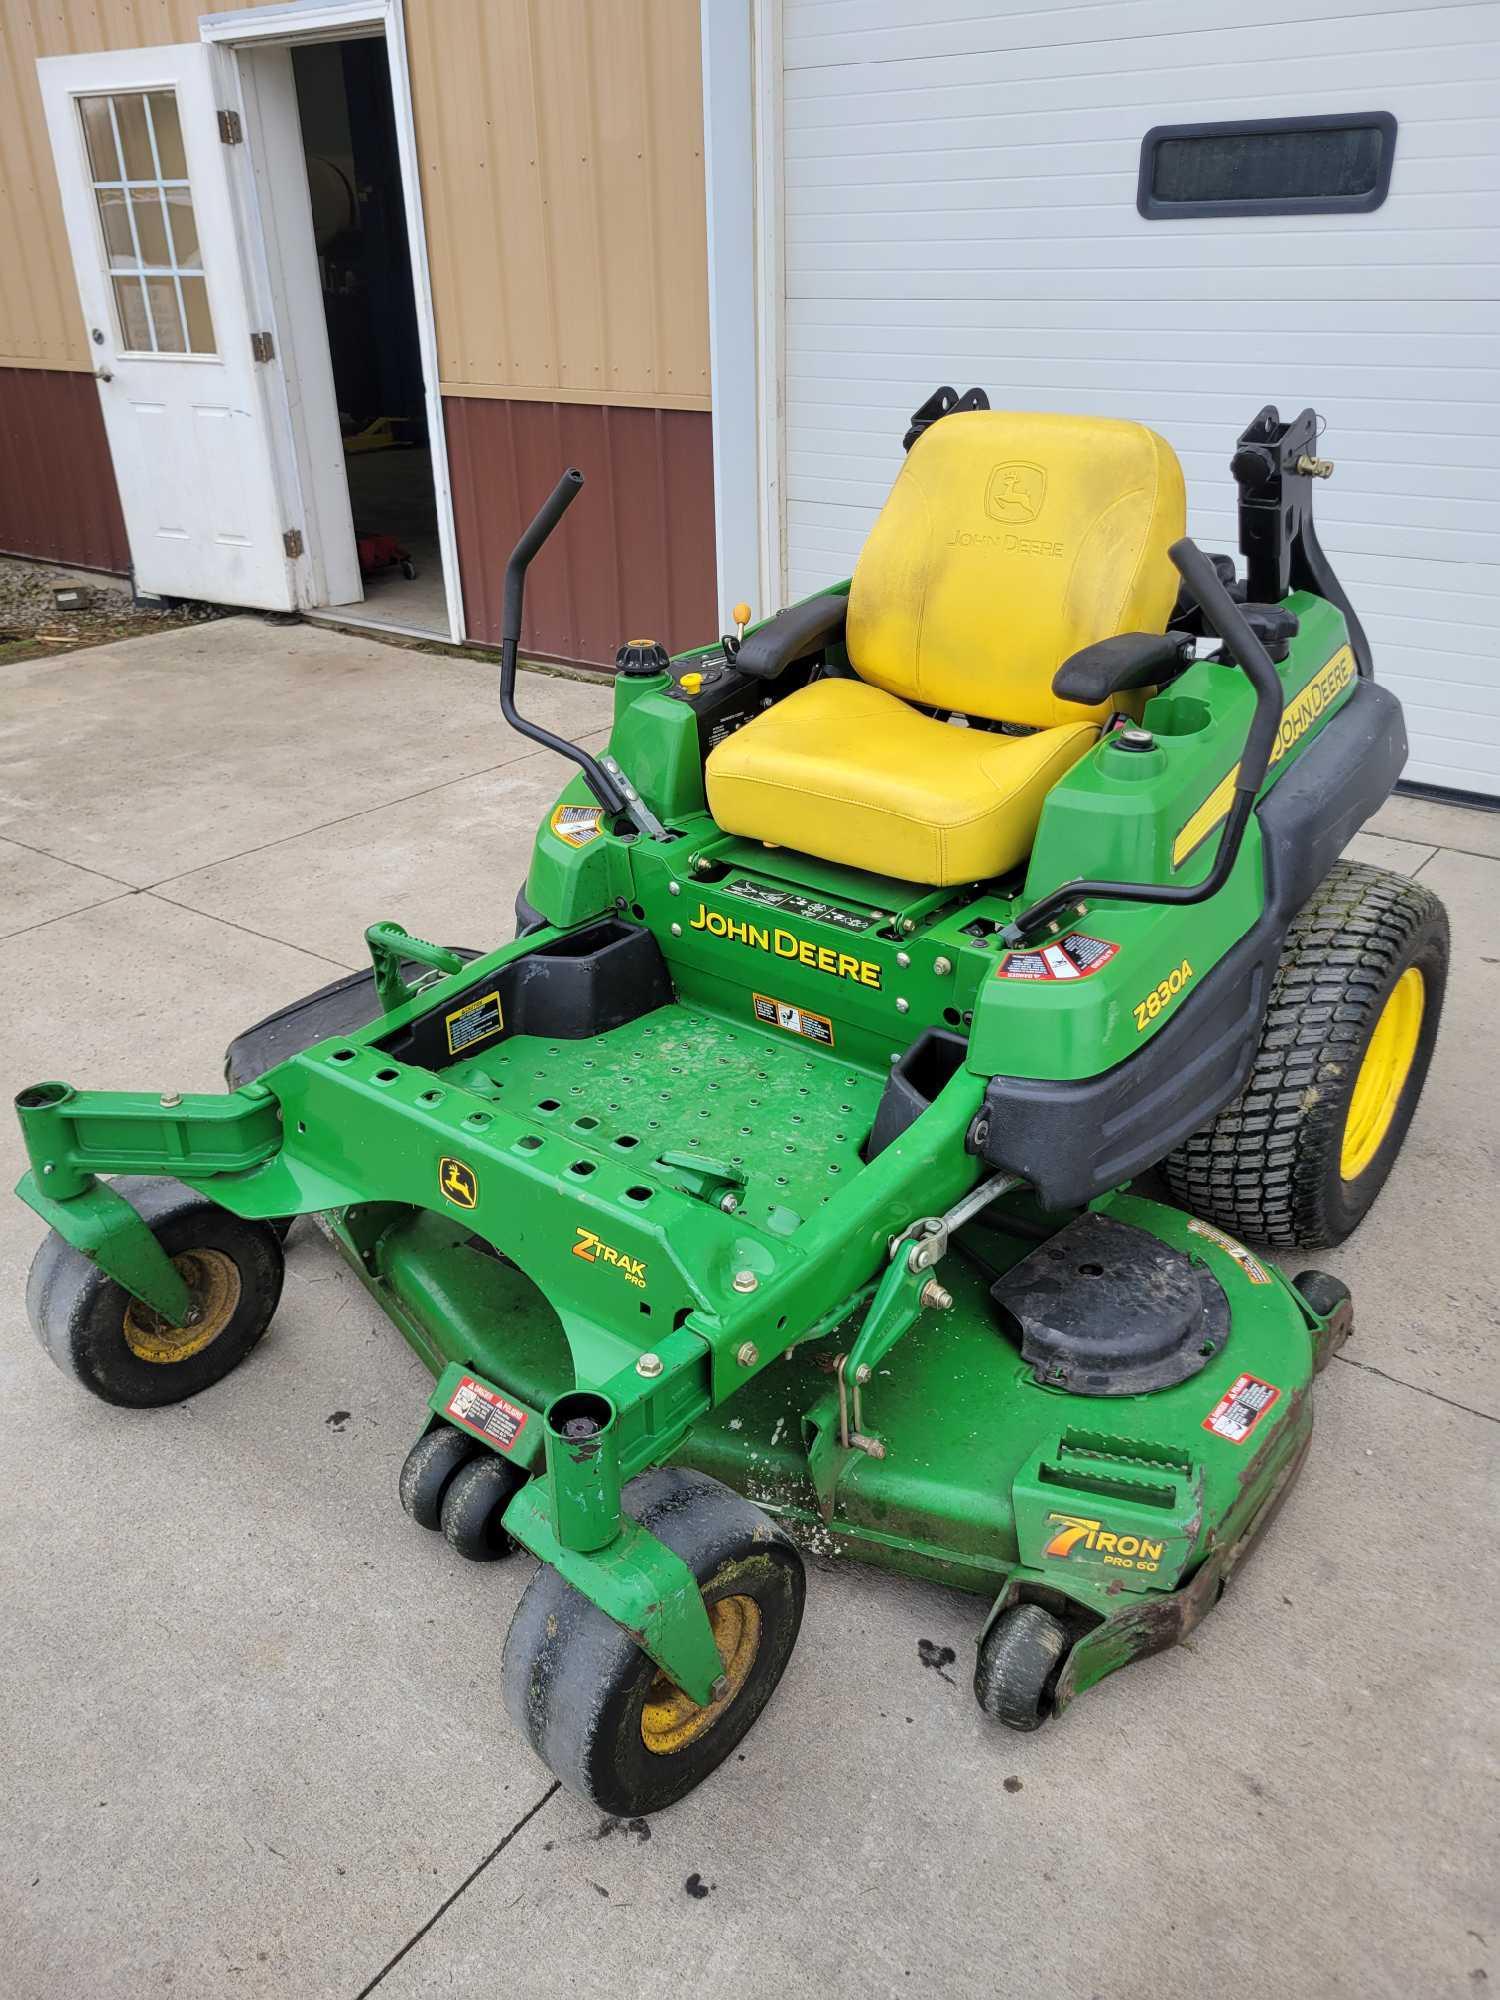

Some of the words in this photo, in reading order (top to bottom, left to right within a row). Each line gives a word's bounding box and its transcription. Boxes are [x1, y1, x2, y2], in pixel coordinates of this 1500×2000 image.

[1004, 533, 1064, 560] DEERE
[1311, 656, 1348, 715] DEERE
[689, 903, 771, 951] JOHN
[774, 927, 882, 991] DEERE
[1133, 959, 1193, 1031] Z830A
[624, 1272, 647, 1289] PRO
[1103, 1555, 1133, 1568] PRO
[1136, 1561, 1157, 1572] 60
